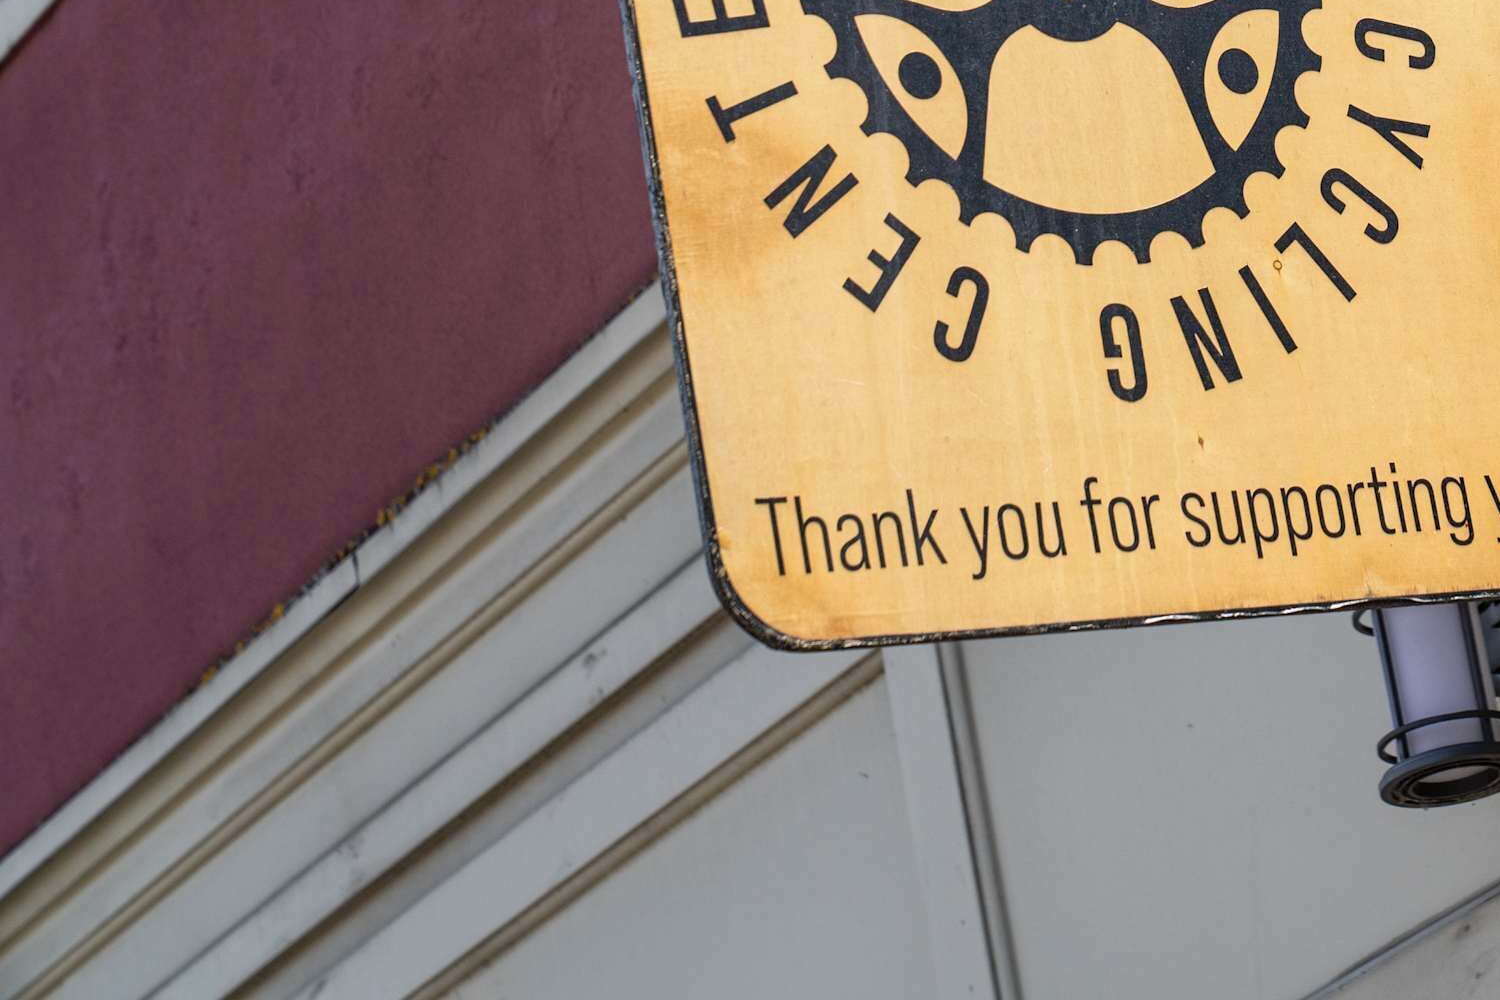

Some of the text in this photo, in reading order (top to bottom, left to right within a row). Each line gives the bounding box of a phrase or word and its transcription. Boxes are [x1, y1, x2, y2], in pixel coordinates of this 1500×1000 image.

[1100, 18, 1436, 403] CYCLING
[754, 489, 948, 577] Thank
[960, 501, 1068, 580] you
[1080, 476, 1160, 554] for
[1180, 462, 1475, 559] supporting
